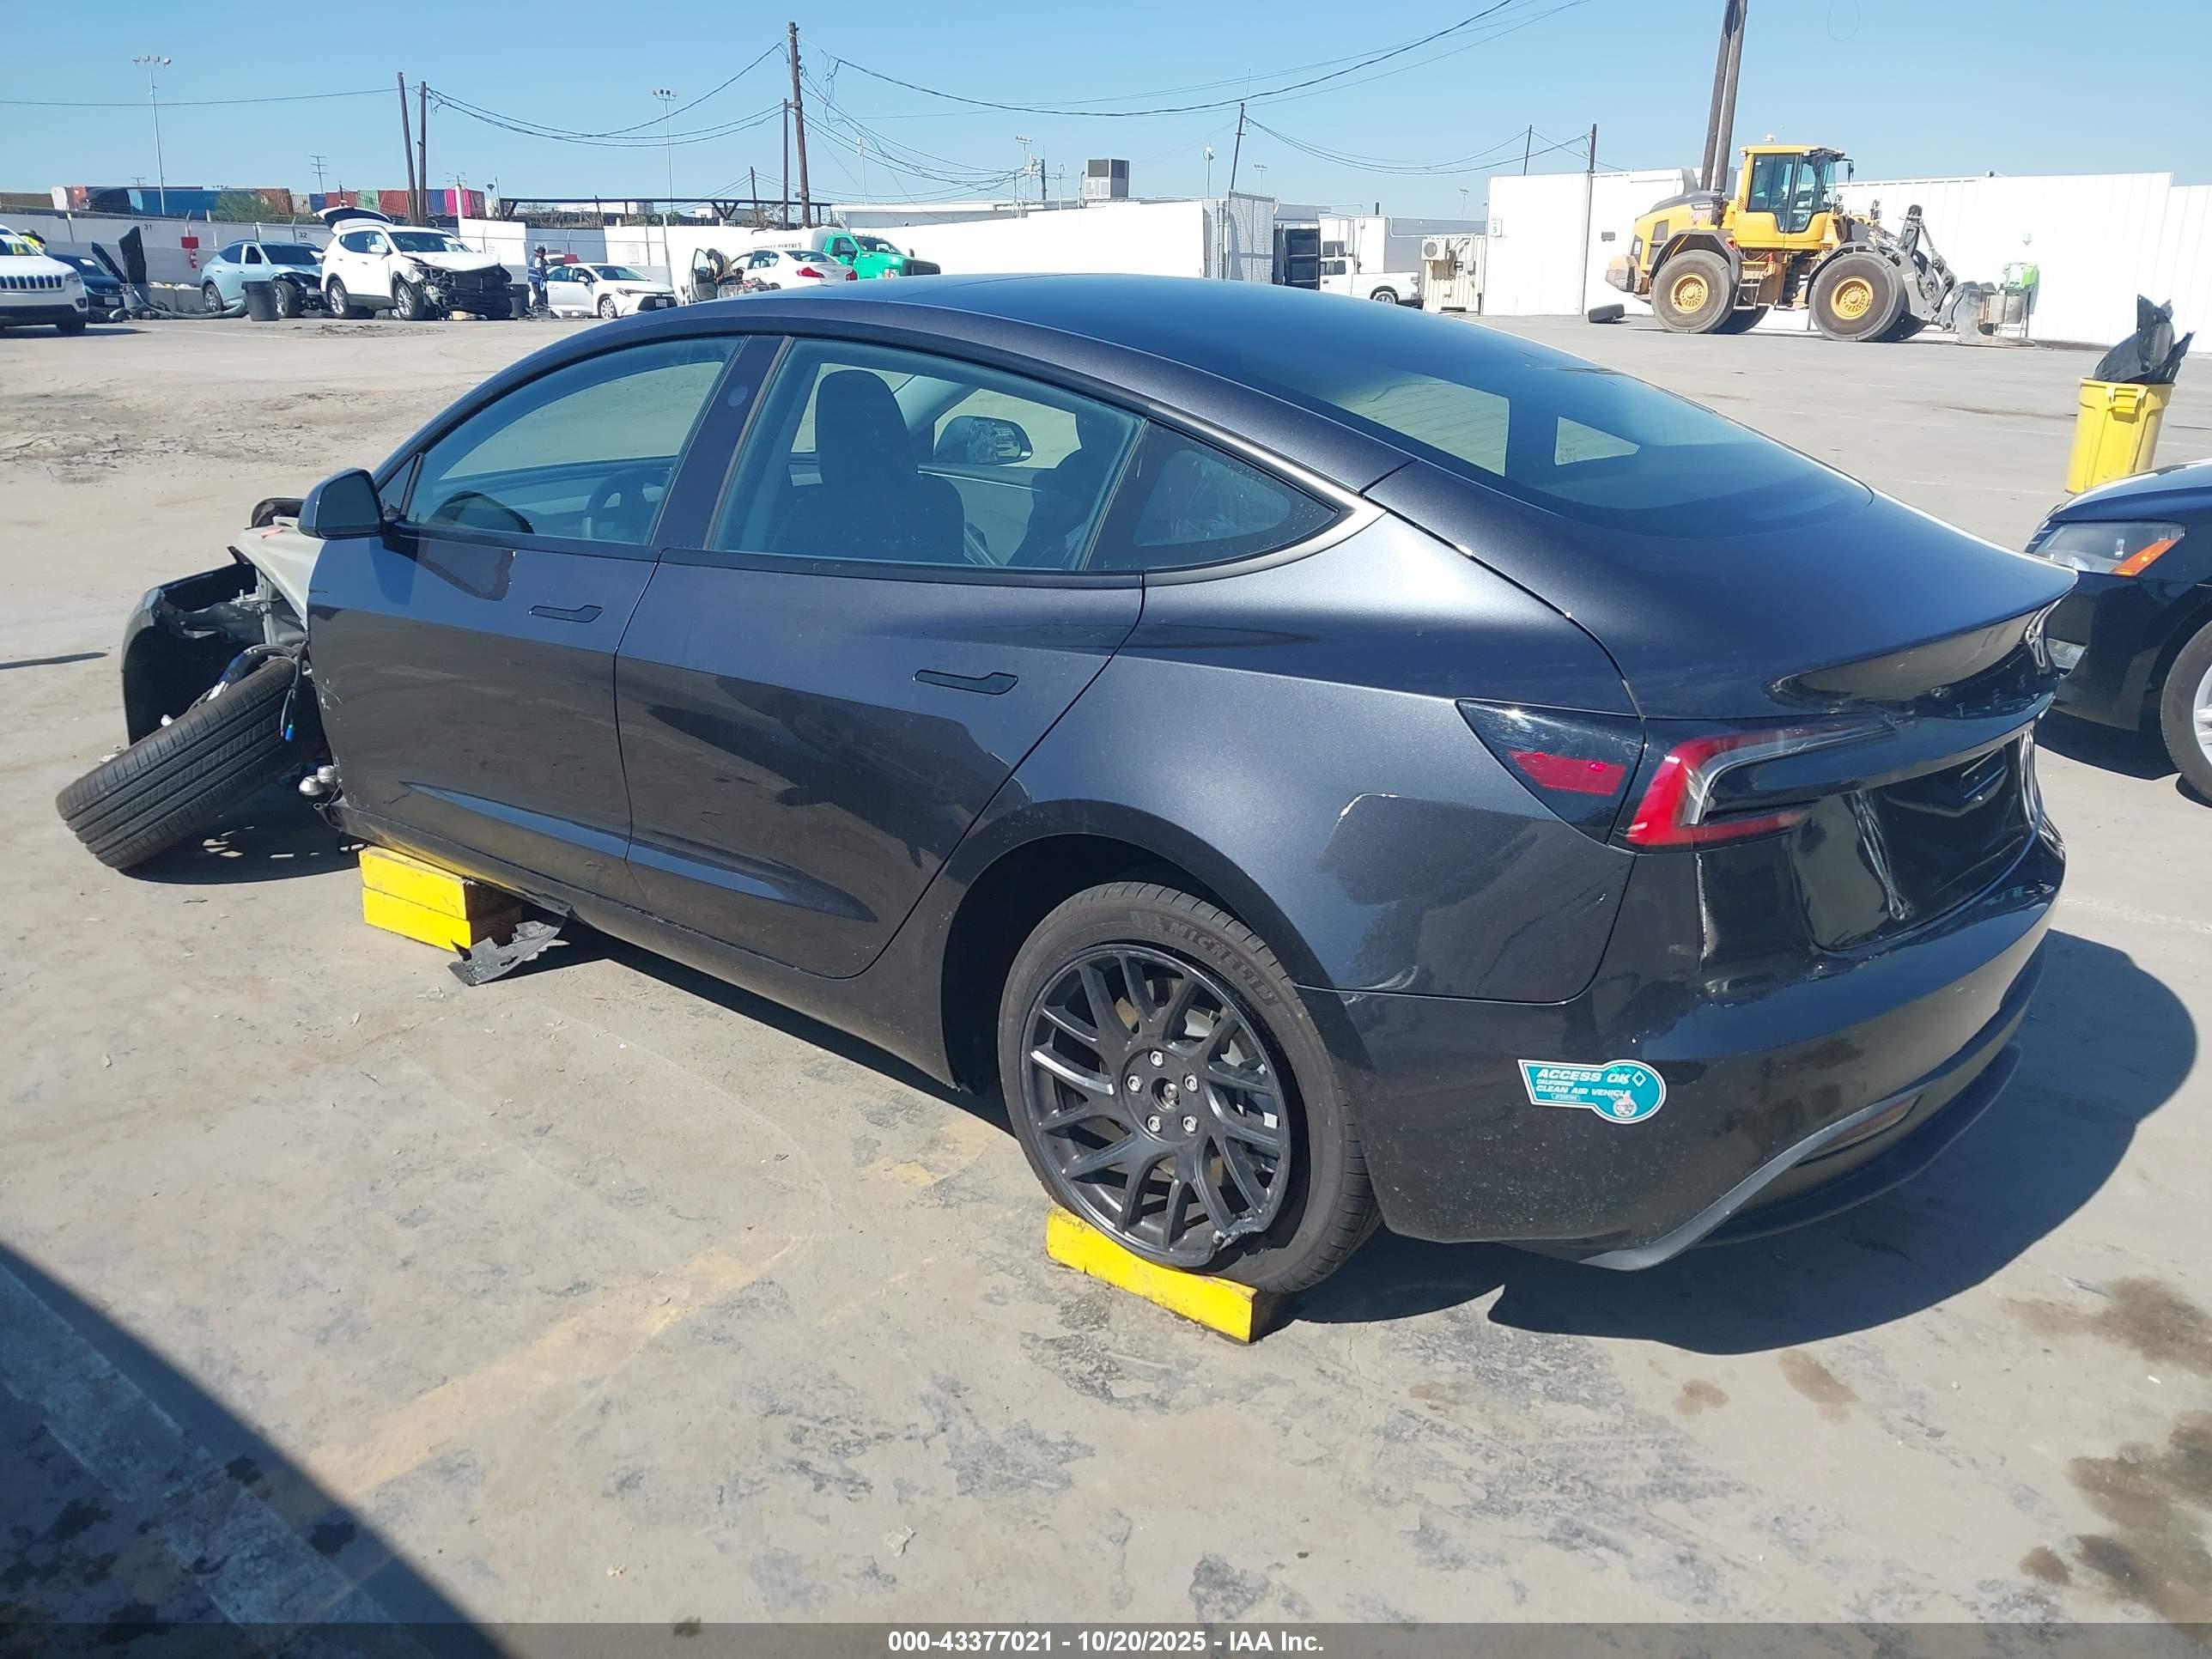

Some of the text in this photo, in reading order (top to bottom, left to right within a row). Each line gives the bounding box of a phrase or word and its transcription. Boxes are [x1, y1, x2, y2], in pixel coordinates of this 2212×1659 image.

[1169, 921, 1280, 1006] MICHELIN
[1536, 1068, 1632, 1085] ACCESS OK
[1535, 1085, 1569, 1094] CLEAN
[1591, 1089, 1632, 1097] VEHICLE
